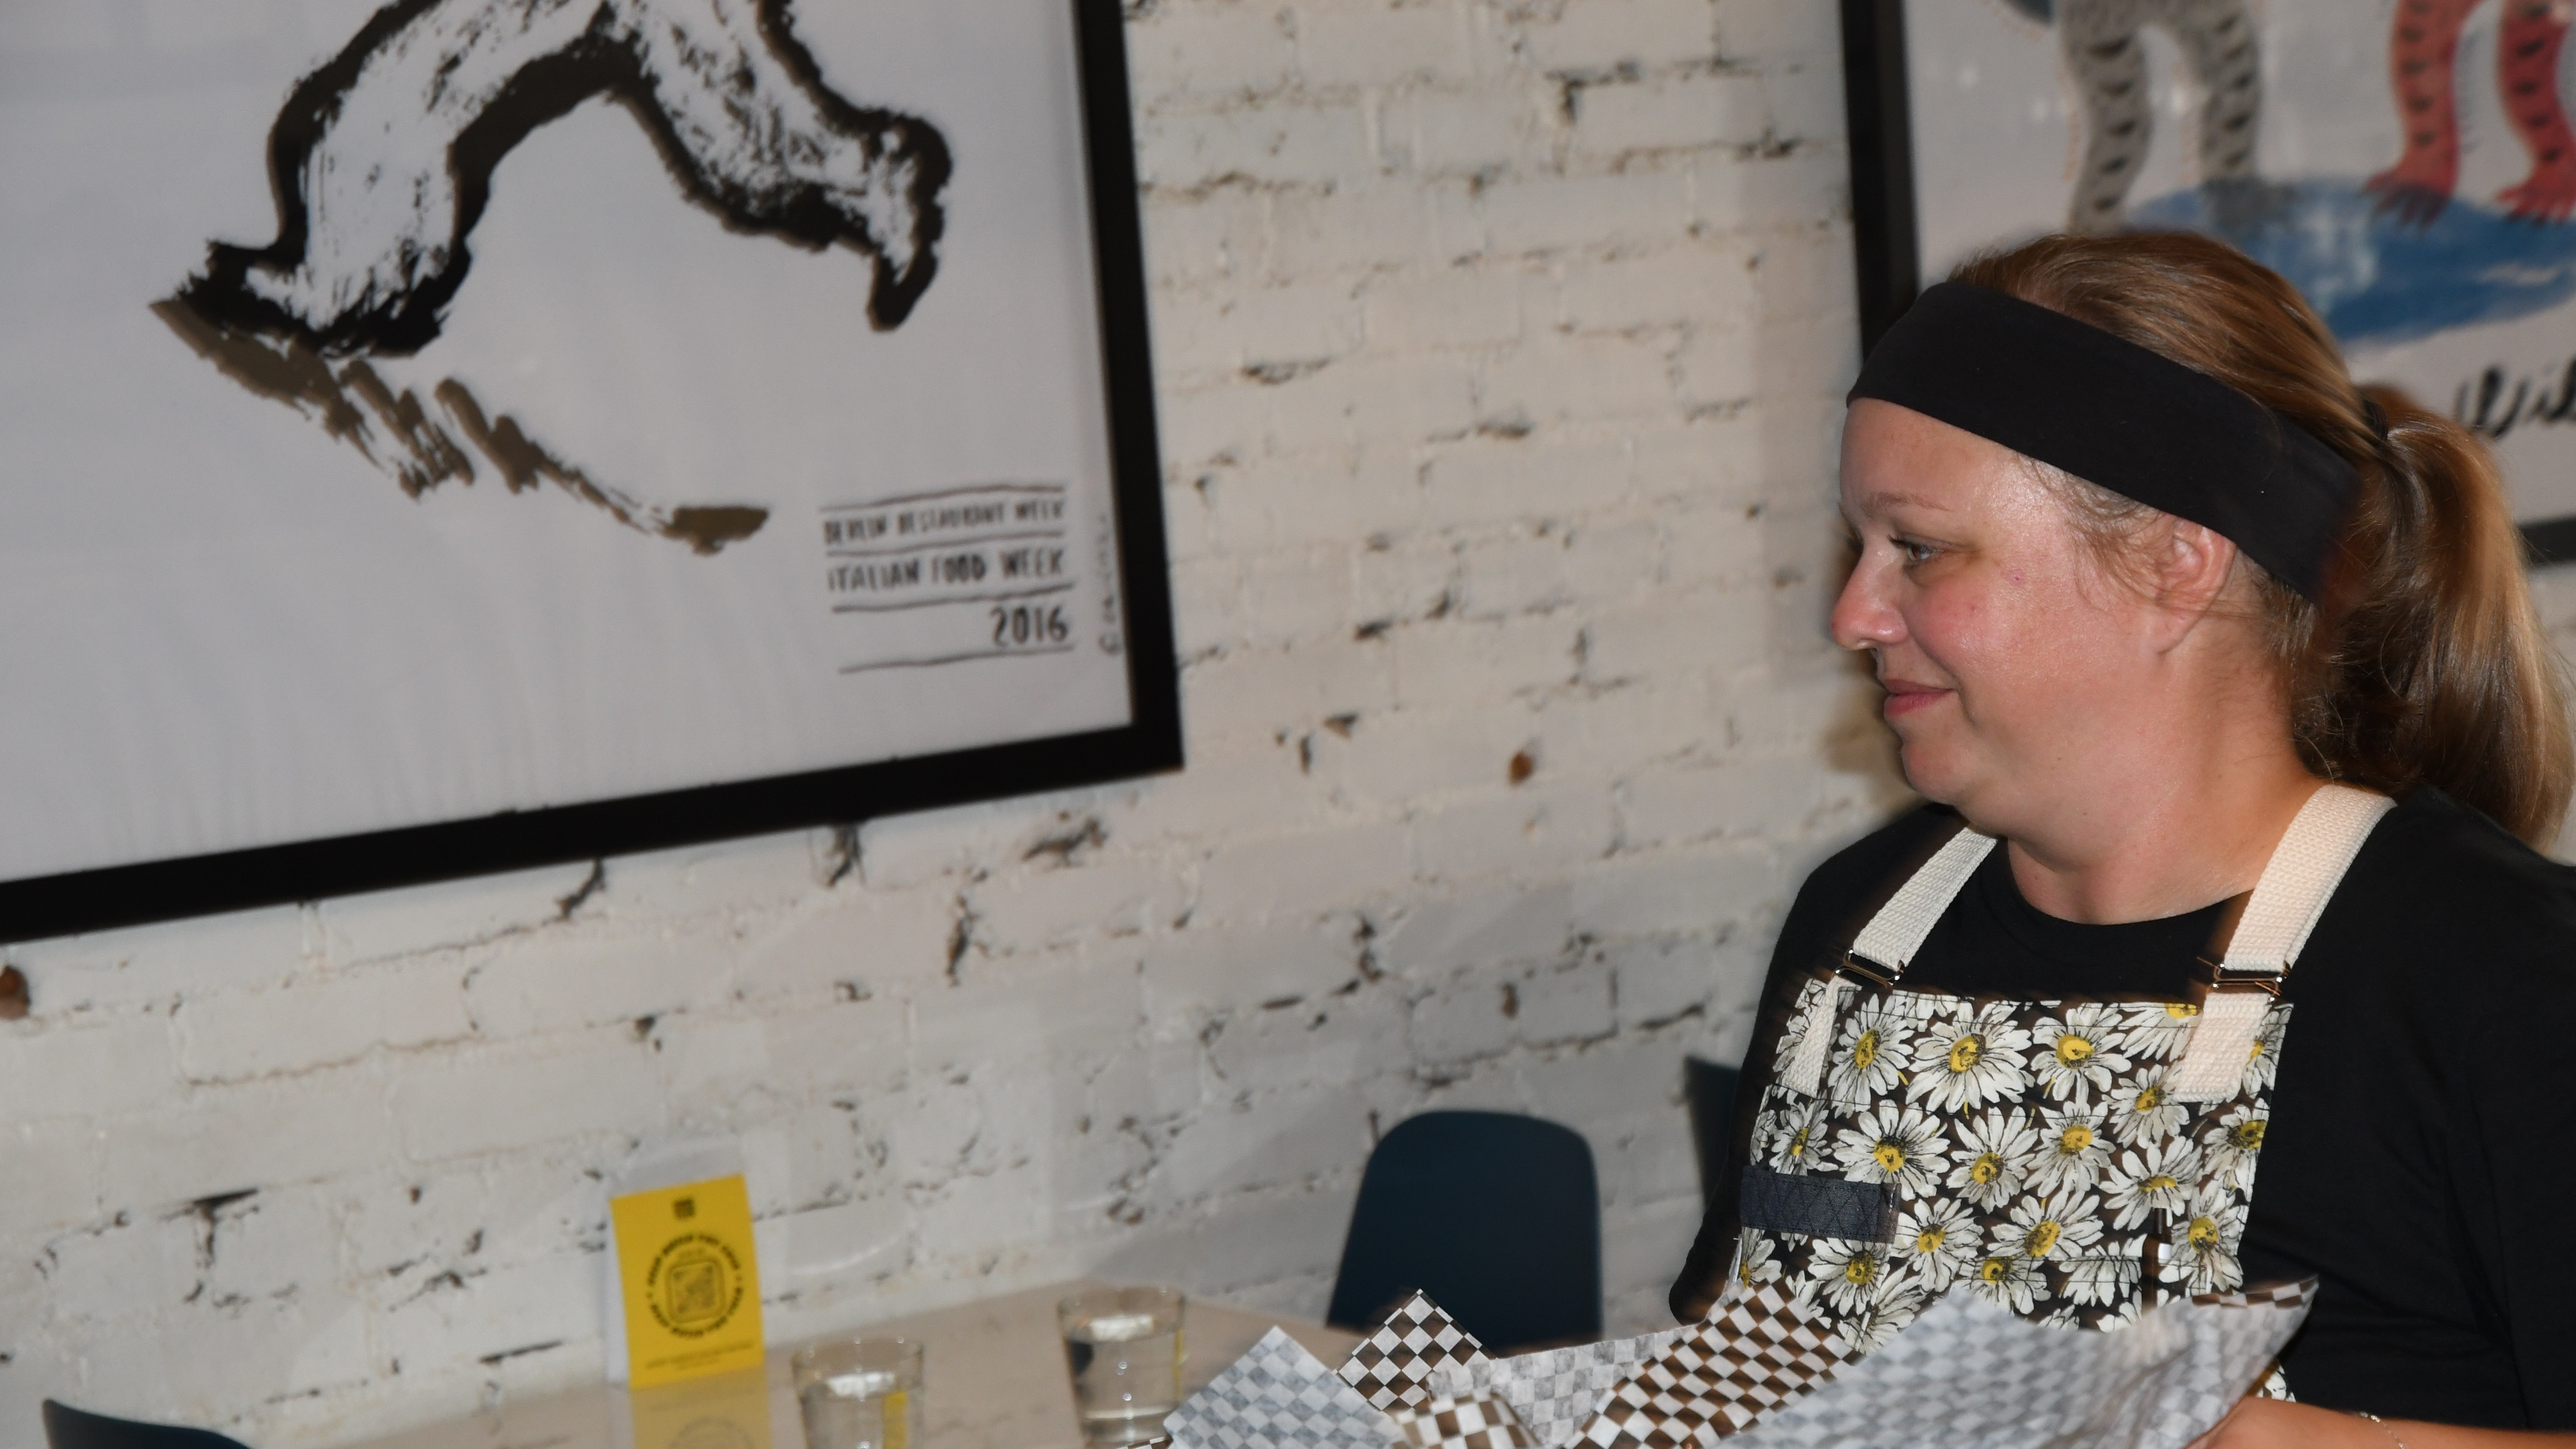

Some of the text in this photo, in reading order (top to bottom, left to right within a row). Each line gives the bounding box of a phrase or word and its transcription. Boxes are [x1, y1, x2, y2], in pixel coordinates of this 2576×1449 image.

[1015, 499, 1066, 521] WEEK
[828, 547, 1064, 592] ITALIAN FOOD WEEK
[990, 605, 1069, 647] 2016
